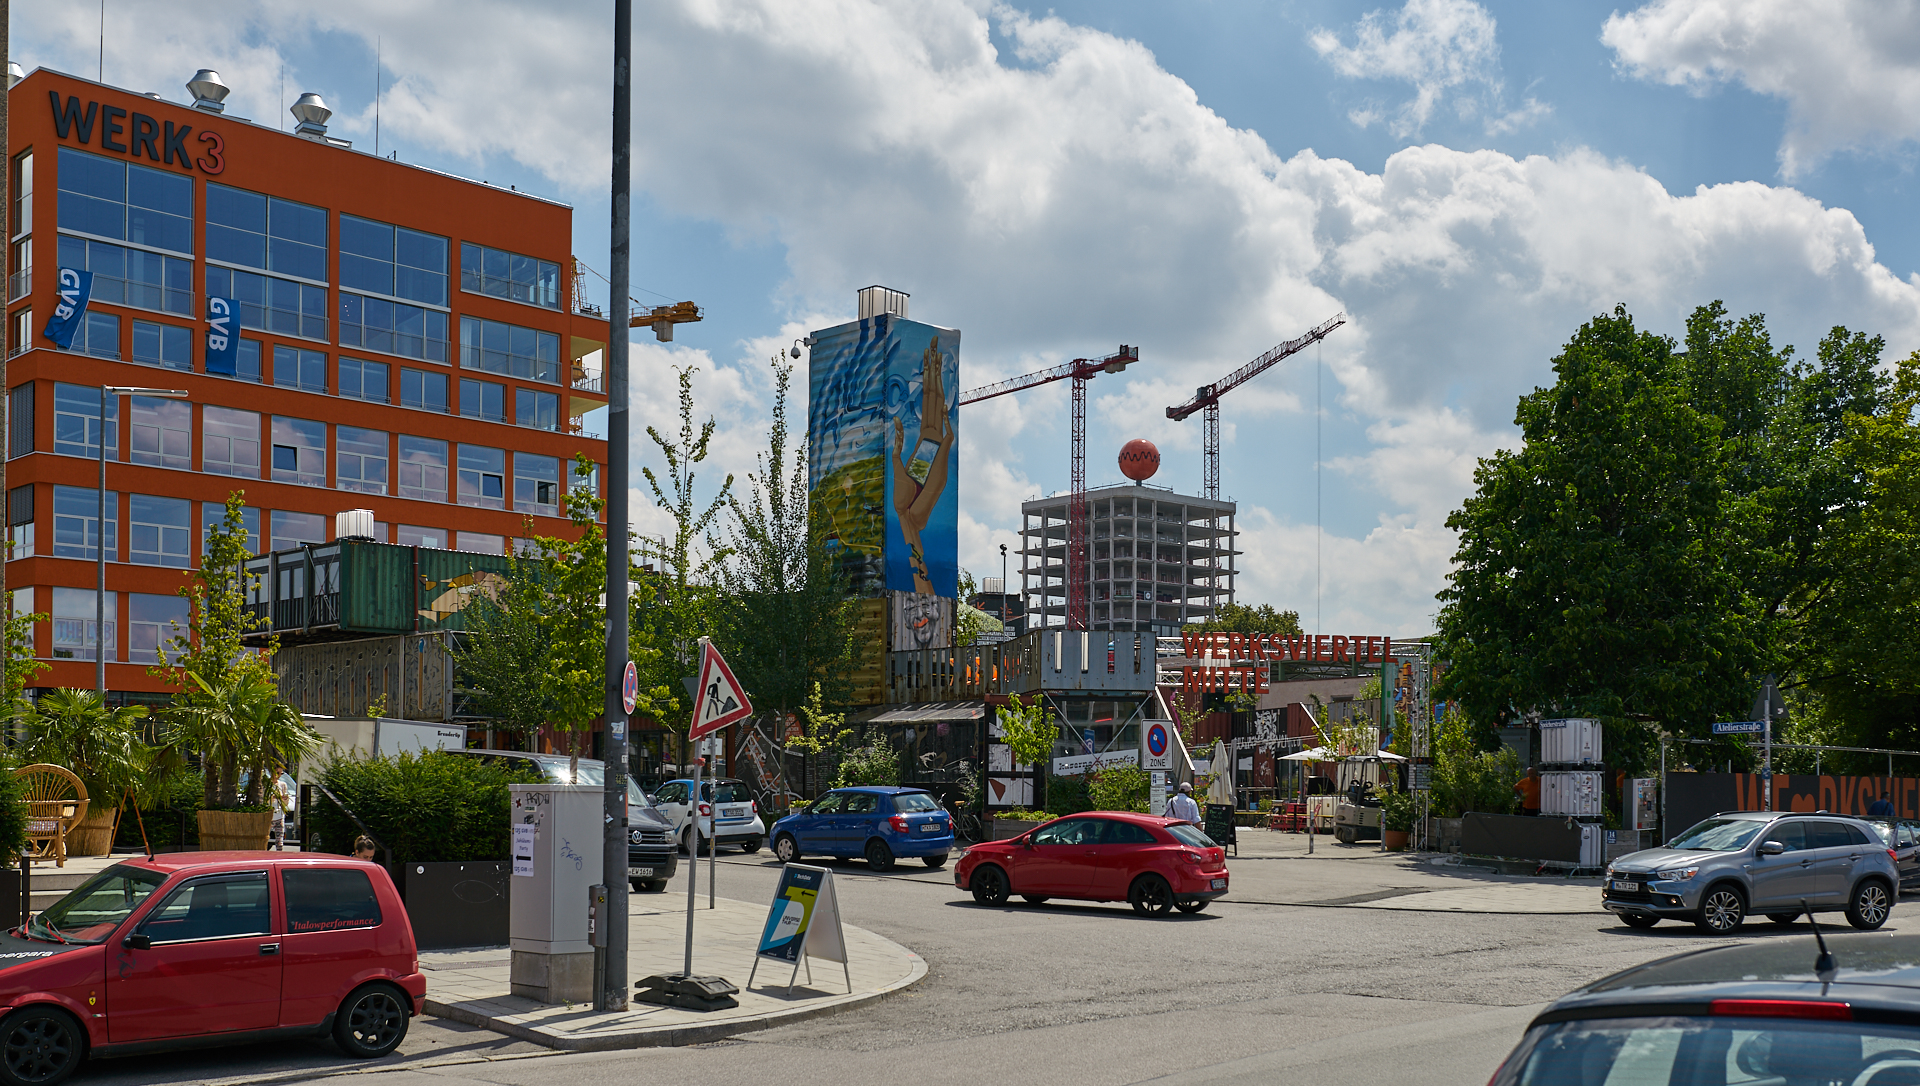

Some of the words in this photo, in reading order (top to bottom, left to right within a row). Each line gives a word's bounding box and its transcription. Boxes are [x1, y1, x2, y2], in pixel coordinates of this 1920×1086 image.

[55, 268, 80, 320] GVB
[208, 297, 230, 351] GVB
[1182, 631, 1398, 664] WERKSVIERTEL
[1183, 665, 1270, 694] MITTE
[1716, 722, 1761, 732] Atelierstraße
[1150, 758, 1166, 767] ZONE
